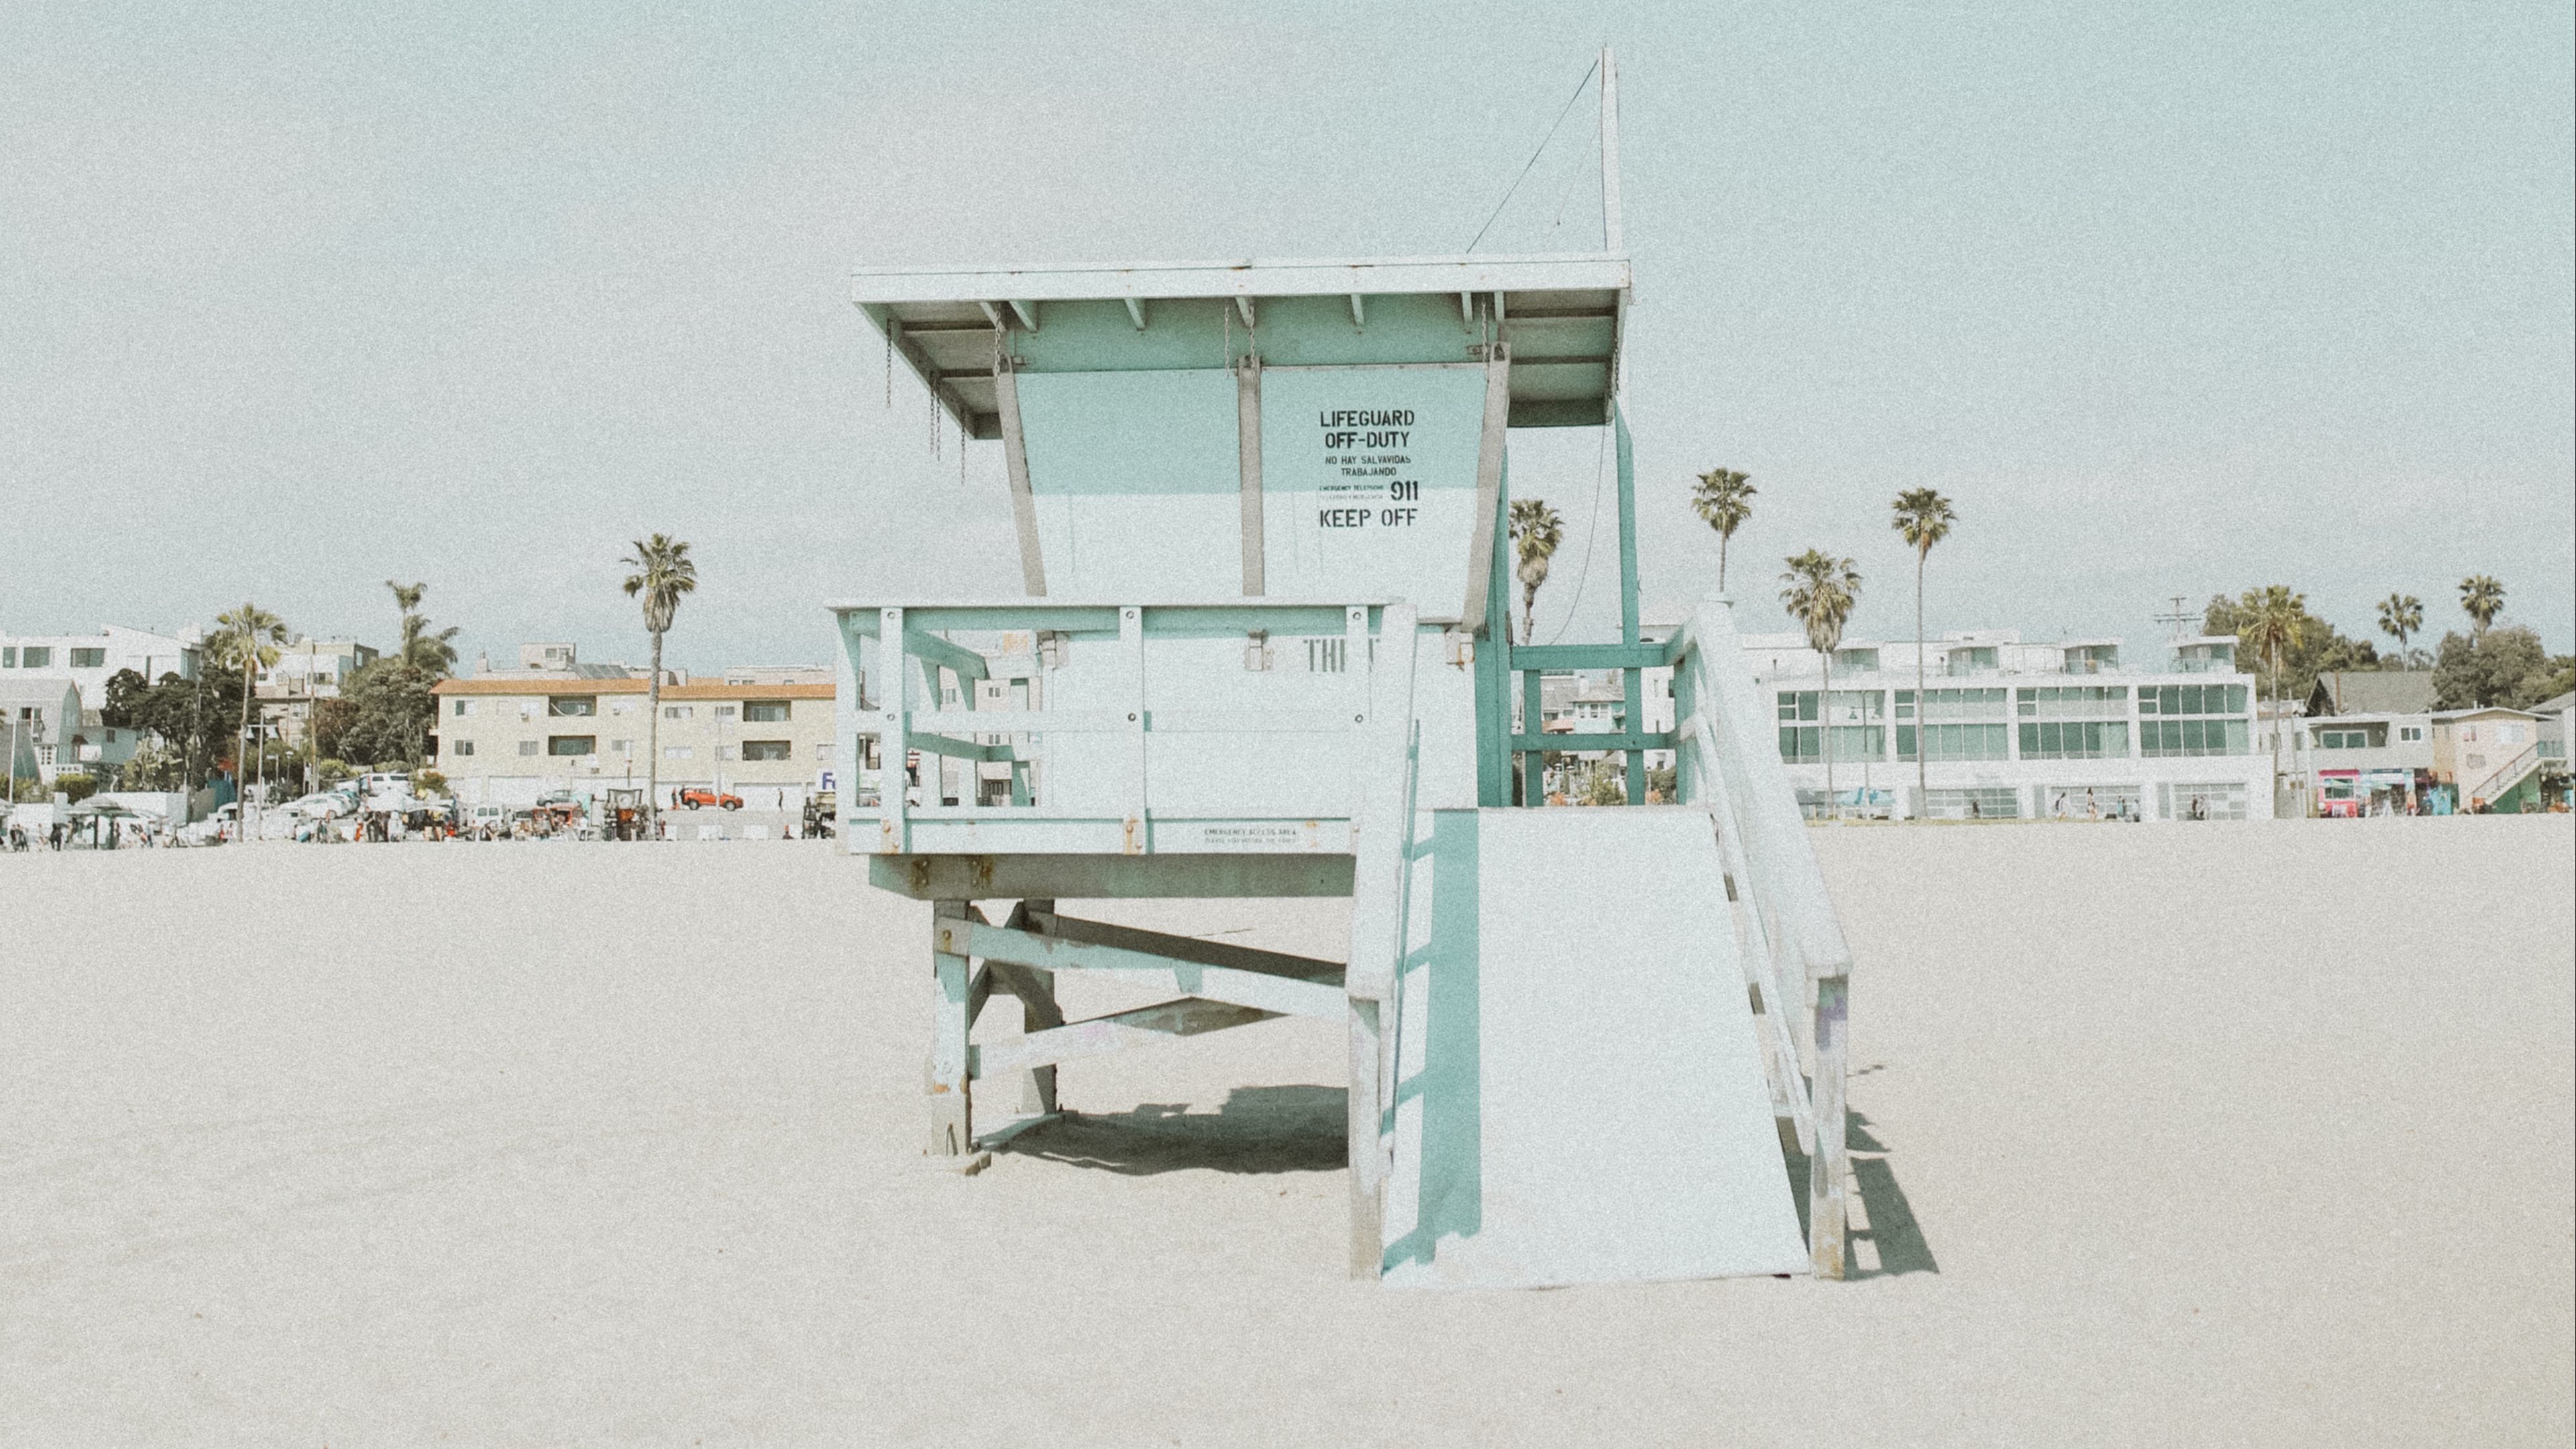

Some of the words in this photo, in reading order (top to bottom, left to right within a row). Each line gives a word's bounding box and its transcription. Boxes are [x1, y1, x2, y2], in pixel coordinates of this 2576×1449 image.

[1320, 410, 1415, 427] LIFEGUARD
[1325, 431, 1410, 449] OFF-DUTY
[1325, 455, 1338, 464] NO
[1341, 455, 1357, 464] HAY
[1361, 455, 1411, 464] SALVAVIDAS
[1341, 467, 1397, 476] TRABAJANDO
[1391, 480, 1418, 501] 911
[1320, 509, 1371, 527] KEEP
[1381, 508, 1418, 527] OFF
